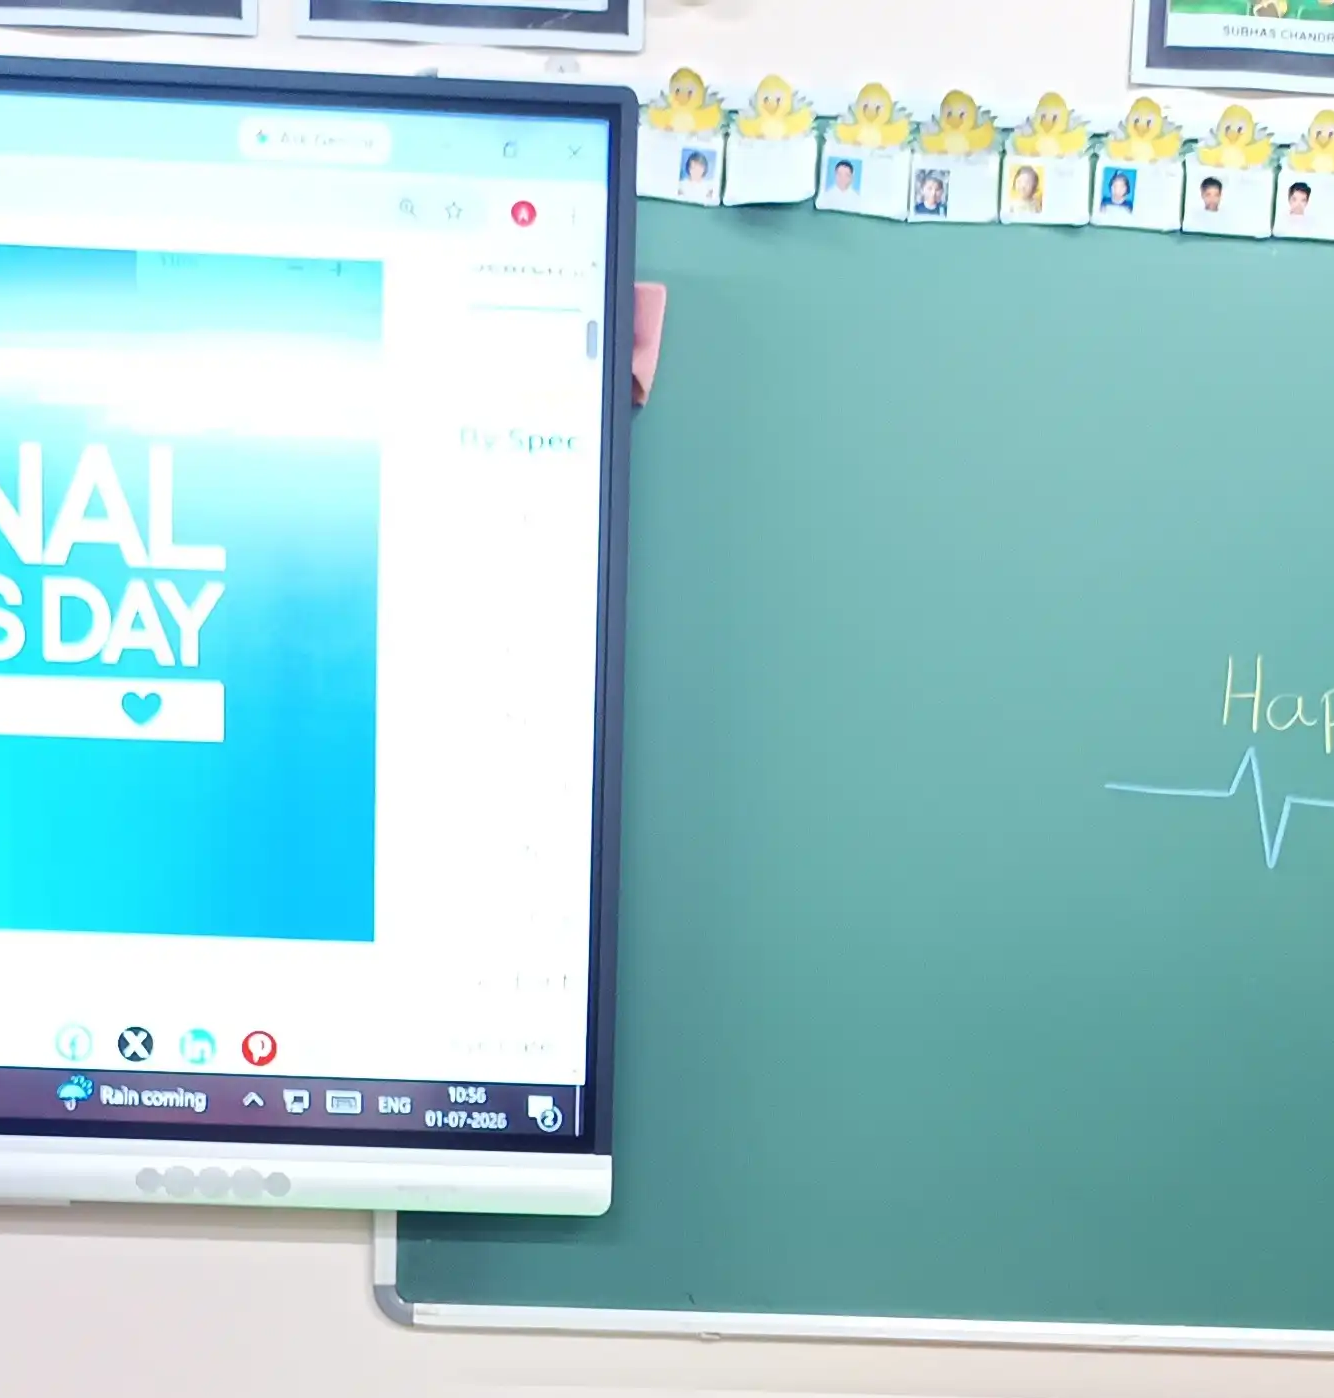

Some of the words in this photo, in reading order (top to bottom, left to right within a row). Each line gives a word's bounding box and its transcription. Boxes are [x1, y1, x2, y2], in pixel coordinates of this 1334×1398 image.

[1222, 25, 1277, 39] SUBHAS
[42, 577, 226, 668] DAY
[100, 1085, 139, 1106] Rain
[141, 1087, 207, 1112] coming
[447, 1086, 487, 1104] 10:56
[378, 1096, 412, 1114] ENG
[424, 1110, 508, 1130] 01-07-2026
